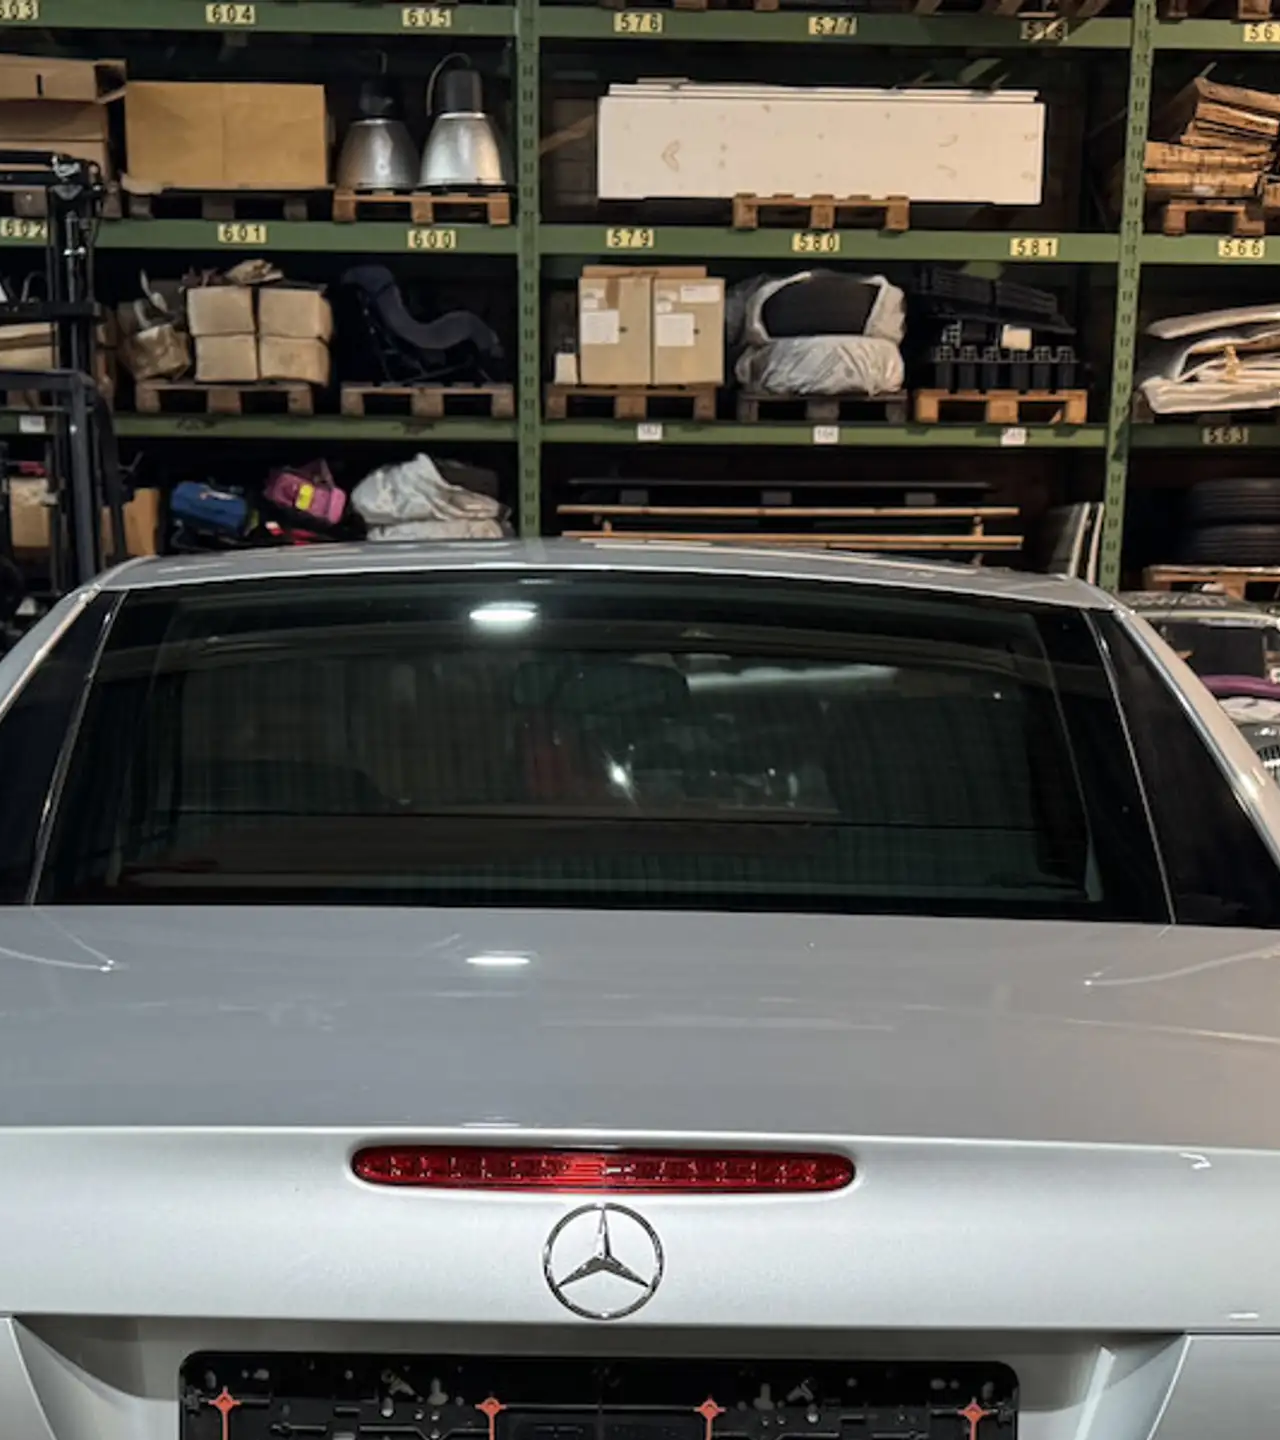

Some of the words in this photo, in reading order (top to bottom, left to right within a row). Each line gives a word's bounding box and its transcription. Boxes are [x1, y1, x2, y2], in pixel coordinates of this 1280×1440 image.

[211, 4, 251, 22] 604
[407, 9, 448, 27] 605
[620, 13, 658, 31] 576
[815, 16, 853, 34] 577
[224, 225, 260, 242] 601
[414, 231, 451, 248] 600
[613, 229, 649, 247] 579
[799, 233, 835, 251] 580
[1016, 239, 1052, 256] 581
[1223, 240, 1260, 256] 566
